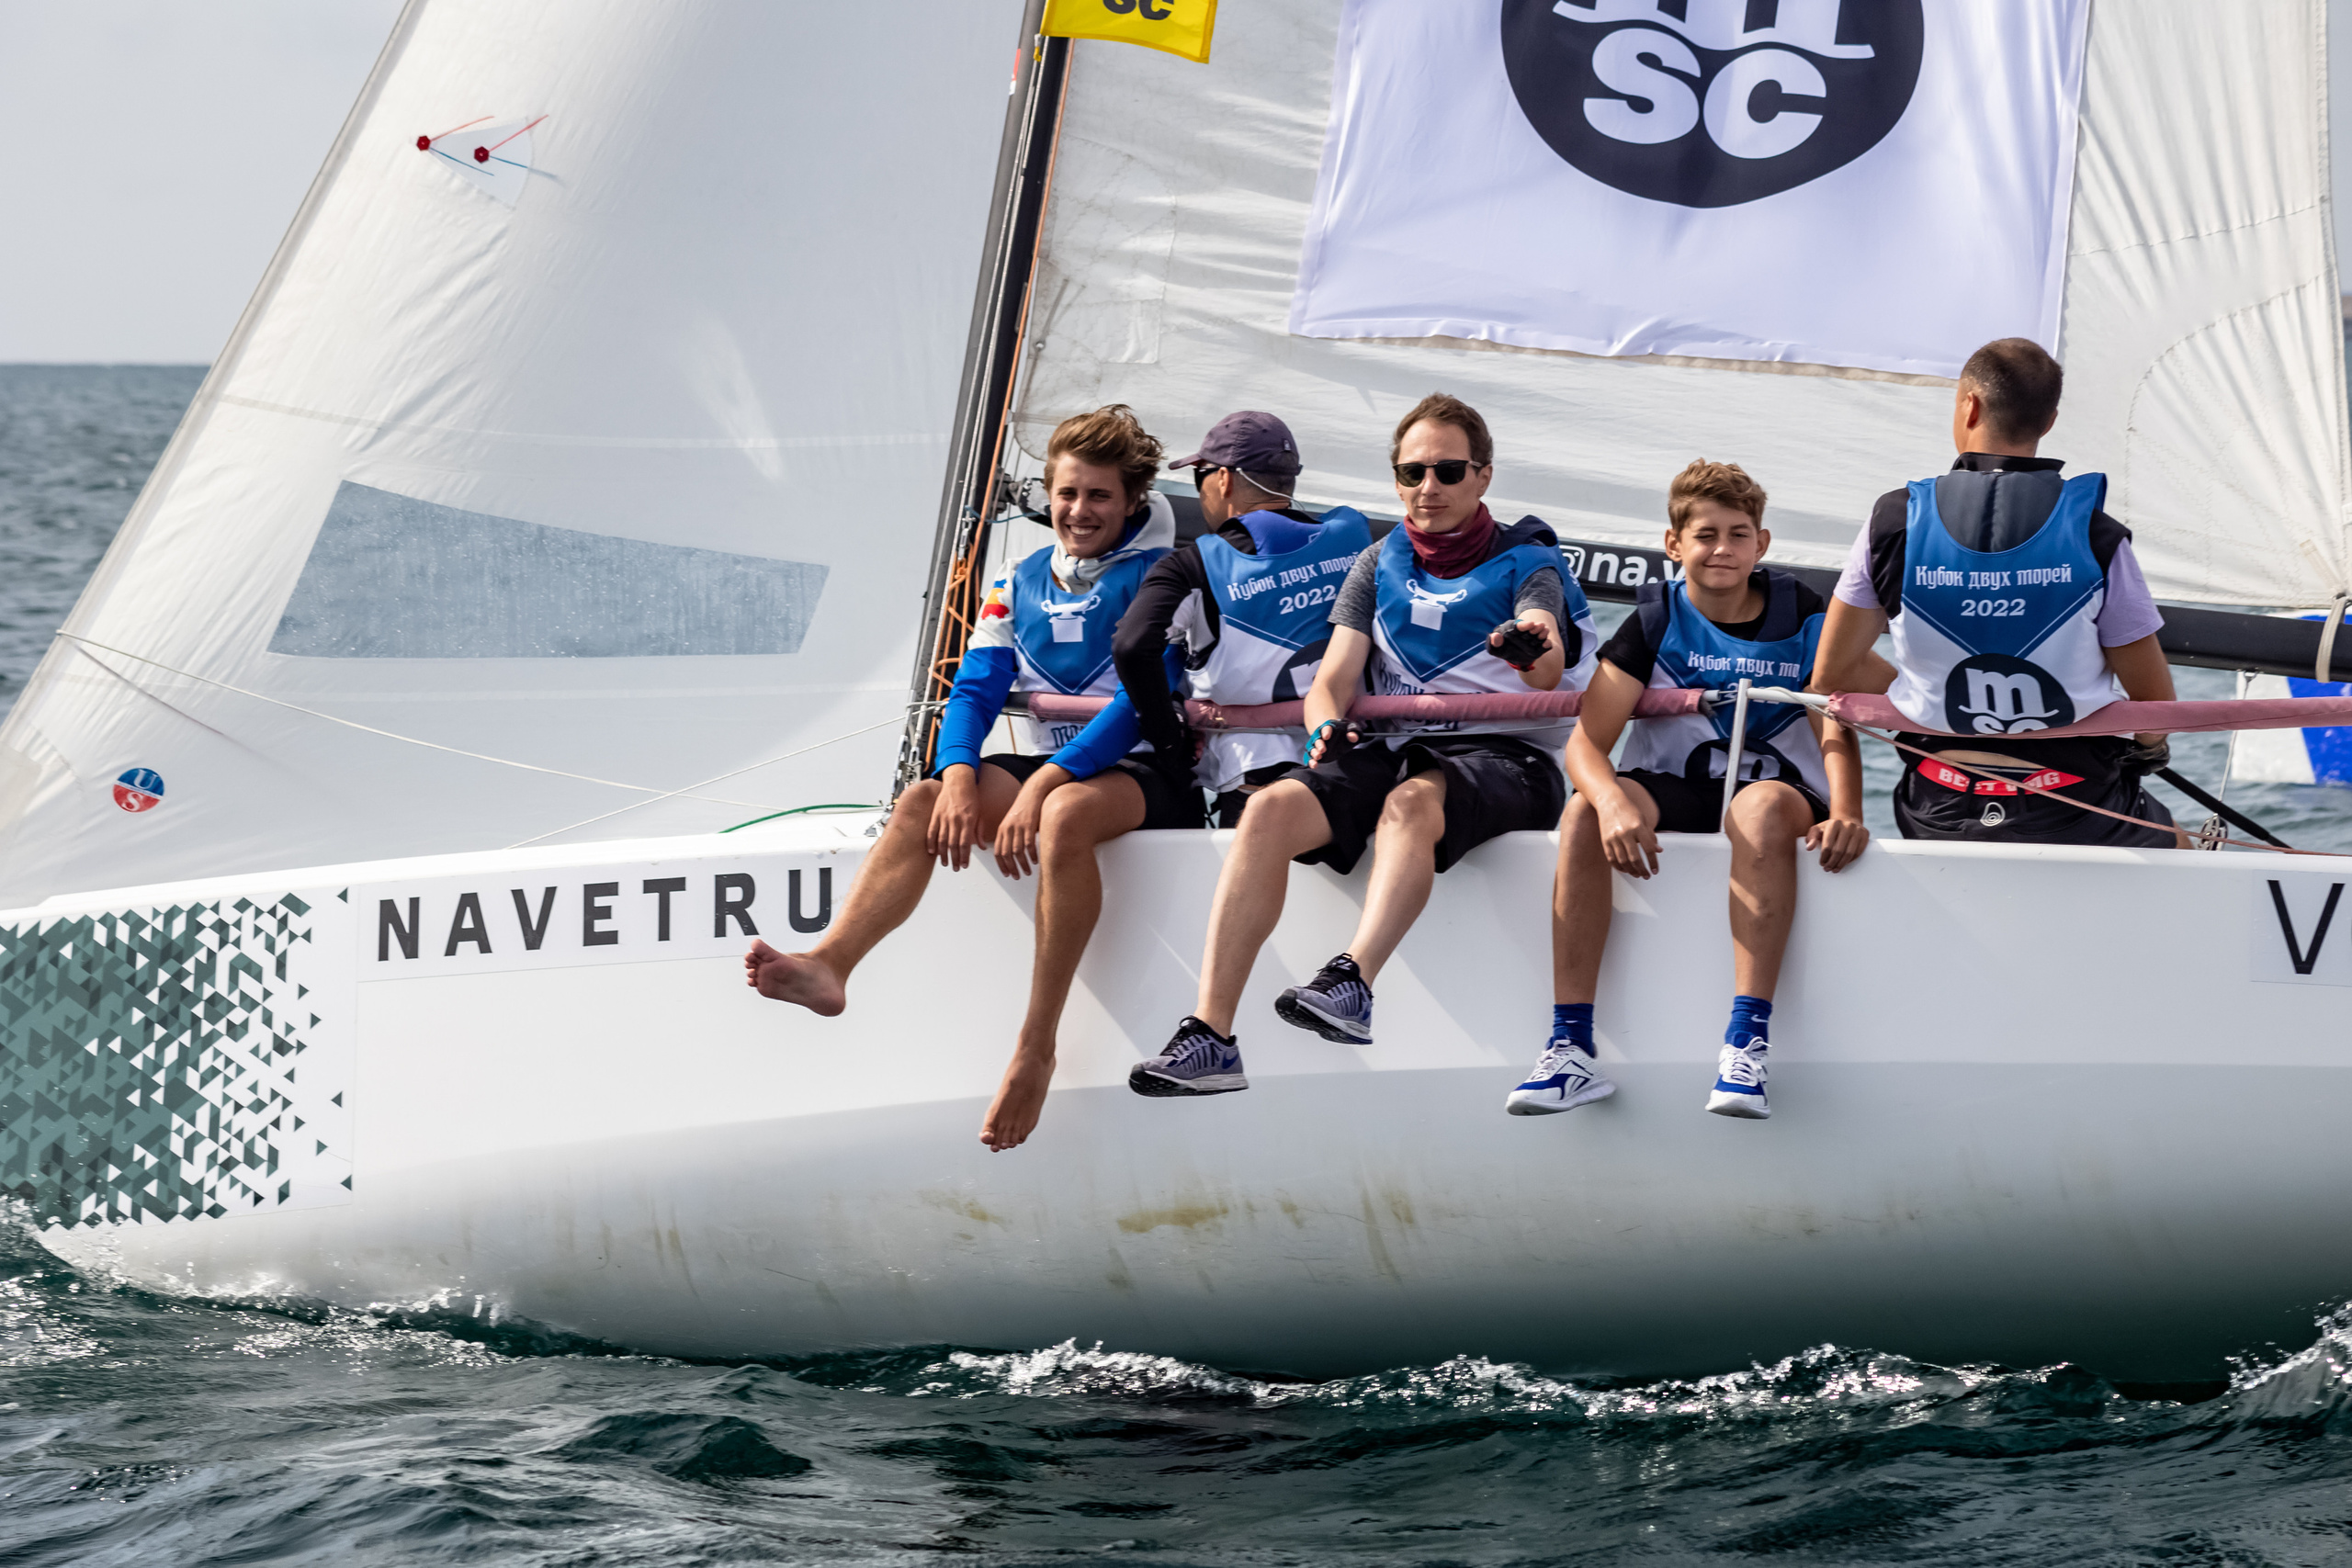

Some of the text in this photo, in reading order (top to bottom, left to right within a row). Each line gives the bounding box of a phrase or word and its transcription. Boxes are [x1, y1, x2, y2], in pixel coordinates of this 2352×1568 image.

[1227, 575, 1277, 602] Кубок
[1279, 563, 1318, 589] двух
[1915, 563, 2073, 591] Кубок двух морей
[1279, 584, 1337, 615] 2022
[1960, 598, 2027, 617] 2022
[1687, 650, 1732, 672] Кубок
[1736, 657, 1776, 678] двух
[378, 867, 832, 962] NAVETRU
